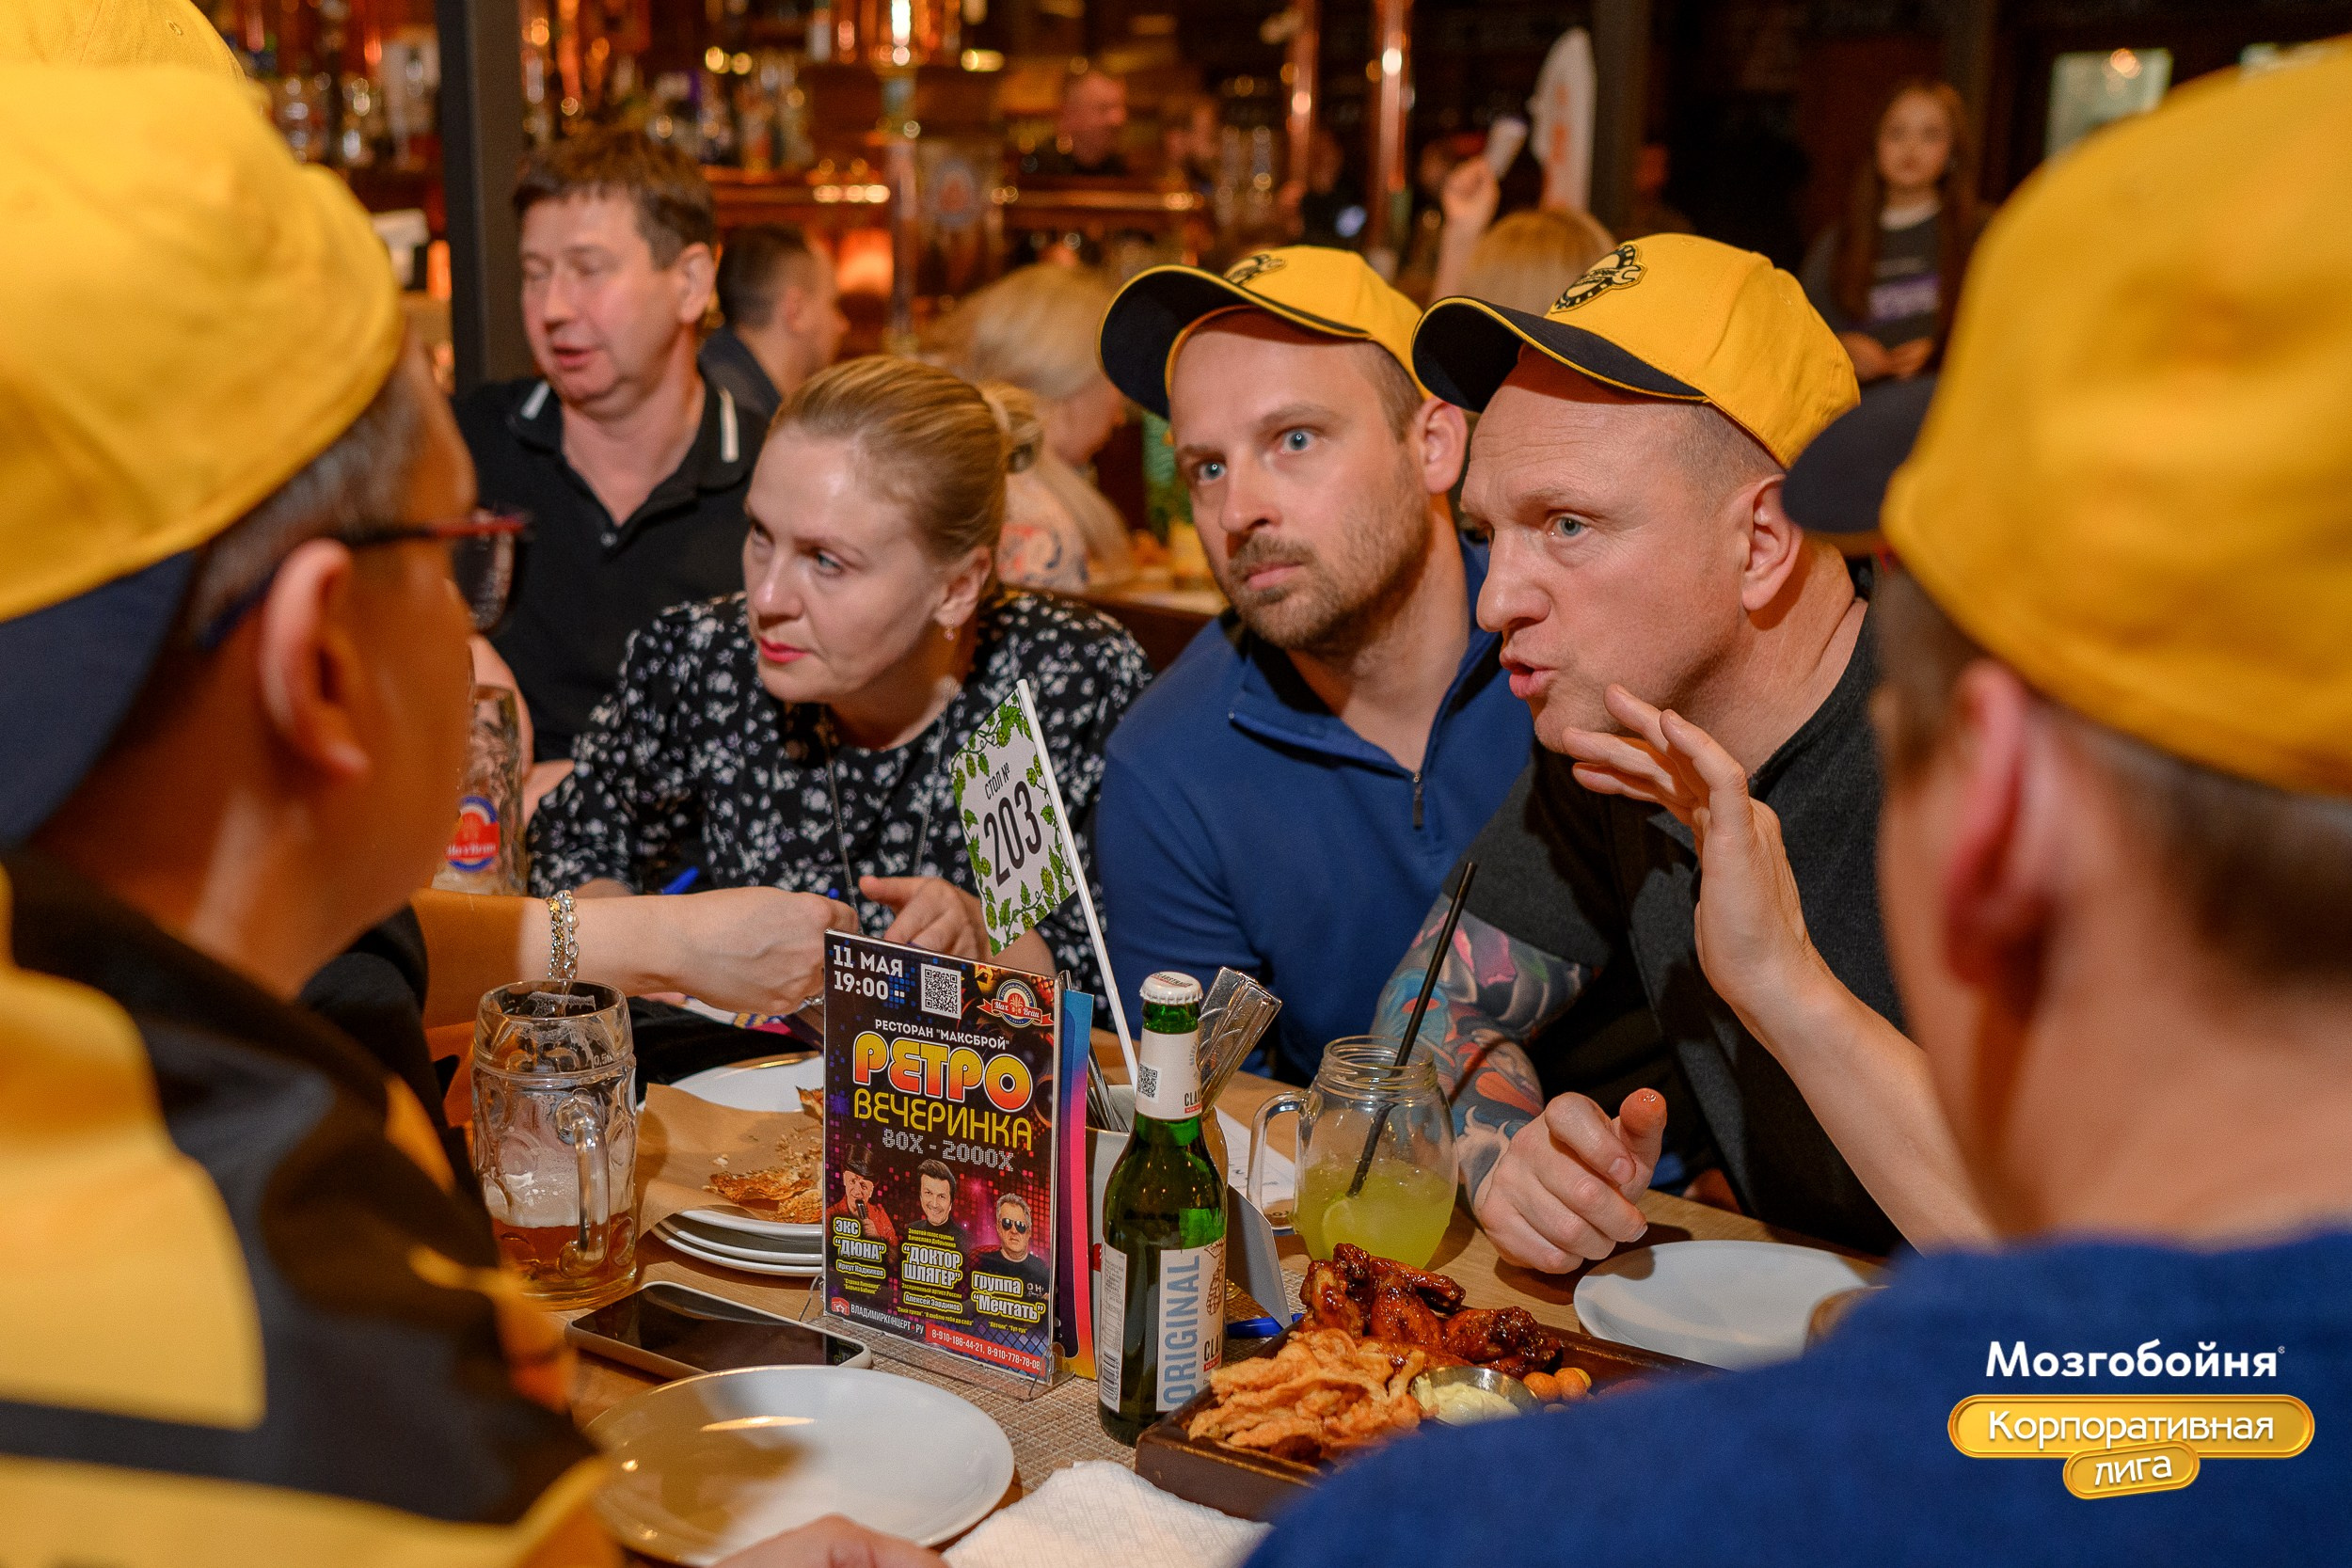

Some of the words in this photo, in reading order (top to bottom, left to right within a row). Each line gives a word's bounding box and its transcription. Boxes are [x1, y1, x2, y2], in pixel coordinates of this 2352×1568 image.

[985, 770, 1003, 800] СТОЛ
[984, 781, 1041, 887] 203
[834, 944, 853, 969] 11
[861, 951, 903, 977] МАЯ
[834, 970, 889, 1000] 19:00
[994, 1002, 1009, 1011] Max
[875, 1019, 933, 1037] РЕСТОРАН
[936, 1029, 1010, 1051] "МАКСБРОЙ"
[853, 1031, 1032, 1112] РЕТРО
[853, 1088, 1032, 1151] ВЕЧЕРИНКА
[835, 1219, 859, 1235] ЭКС
[905, 1294, 930, 1306] Алексей
[974, 1274, 1022, 1295] группа
[1163, 1255, 1200, 1405] ORIGINAL
